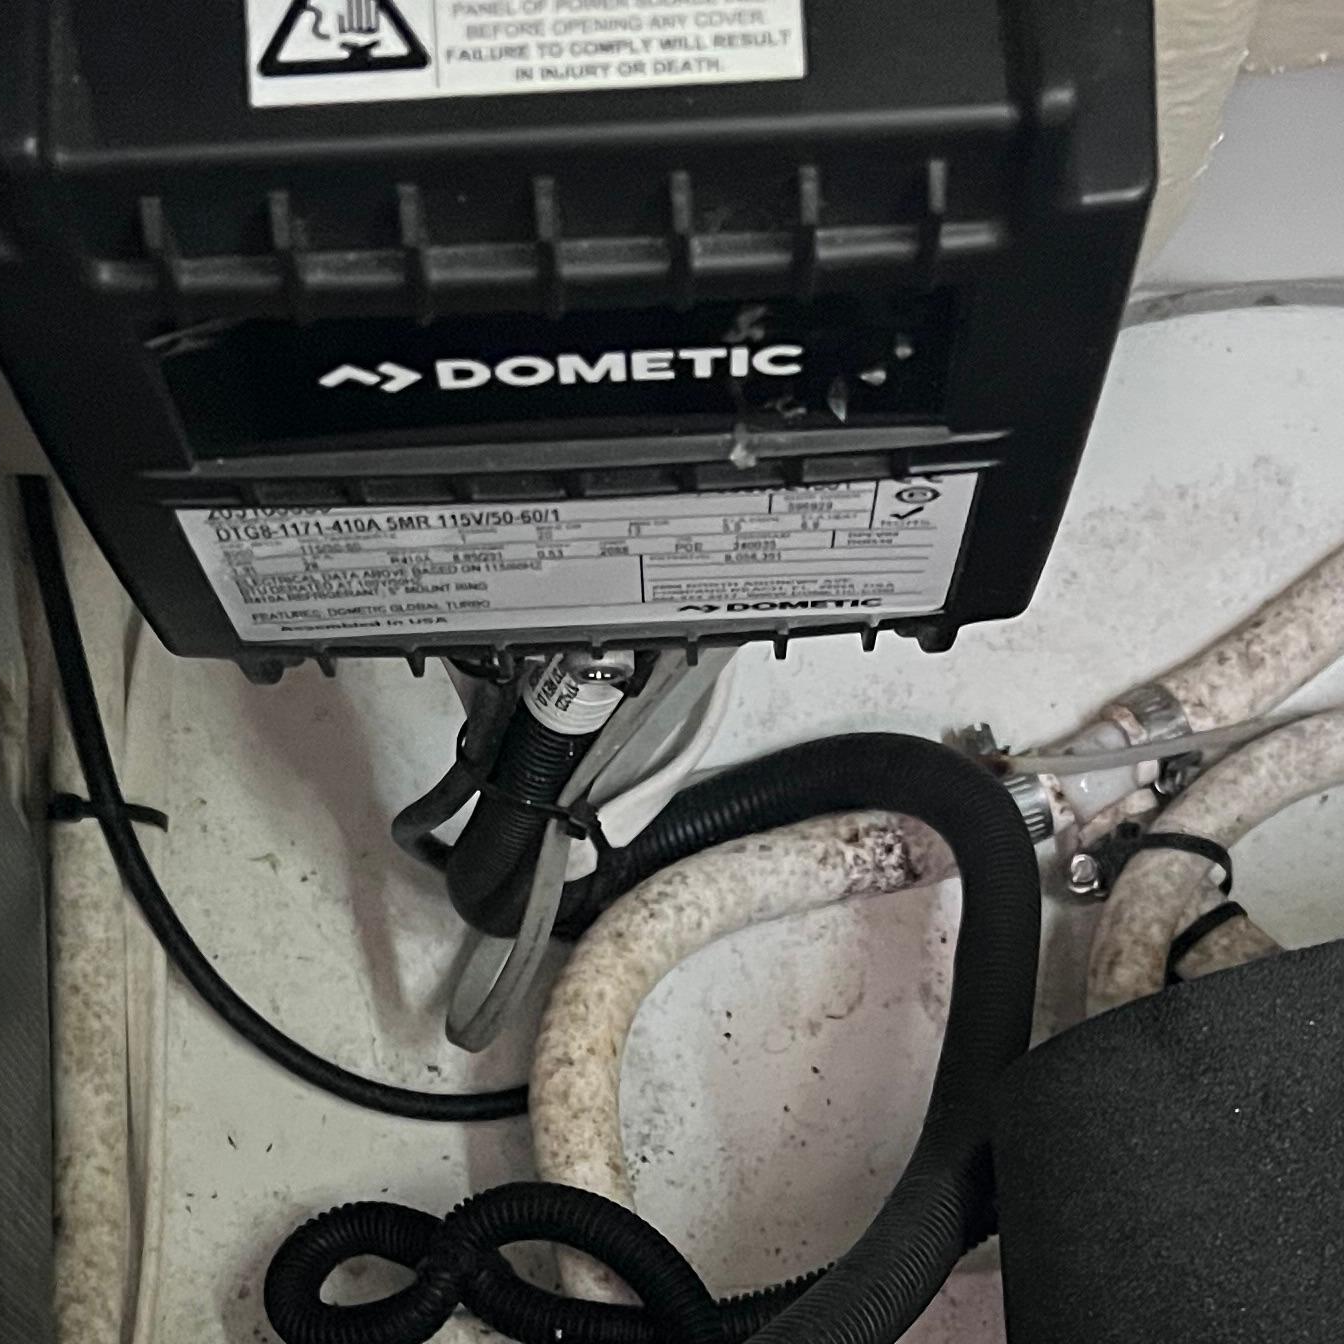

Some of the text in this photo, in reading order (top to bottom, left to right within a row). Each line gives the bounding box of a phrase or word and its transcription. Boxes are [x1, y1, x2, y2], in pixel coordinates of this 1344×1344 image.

[467, 21, 546, 40] BEFORE
[552, 16, 642, 35] OPENING
[650, 14, 687, 29] ANY
[446, 29, 792, 63] FAILURE TO COMPLY WILL RESULT
[516, 67, 533, 81] IN
[541, 62, 611, 81] INJURY
[618, 59, 646, 76] OR
[435, 345, 803, 390] DOMETIC
[215, 517, 382, 542] DTG8-1171-410A
[386, 514, 432, 531] 5MR
[438, 508, 561, 529] 115V/50-60/1
[727, 598, 883, 613] DOMETIC
